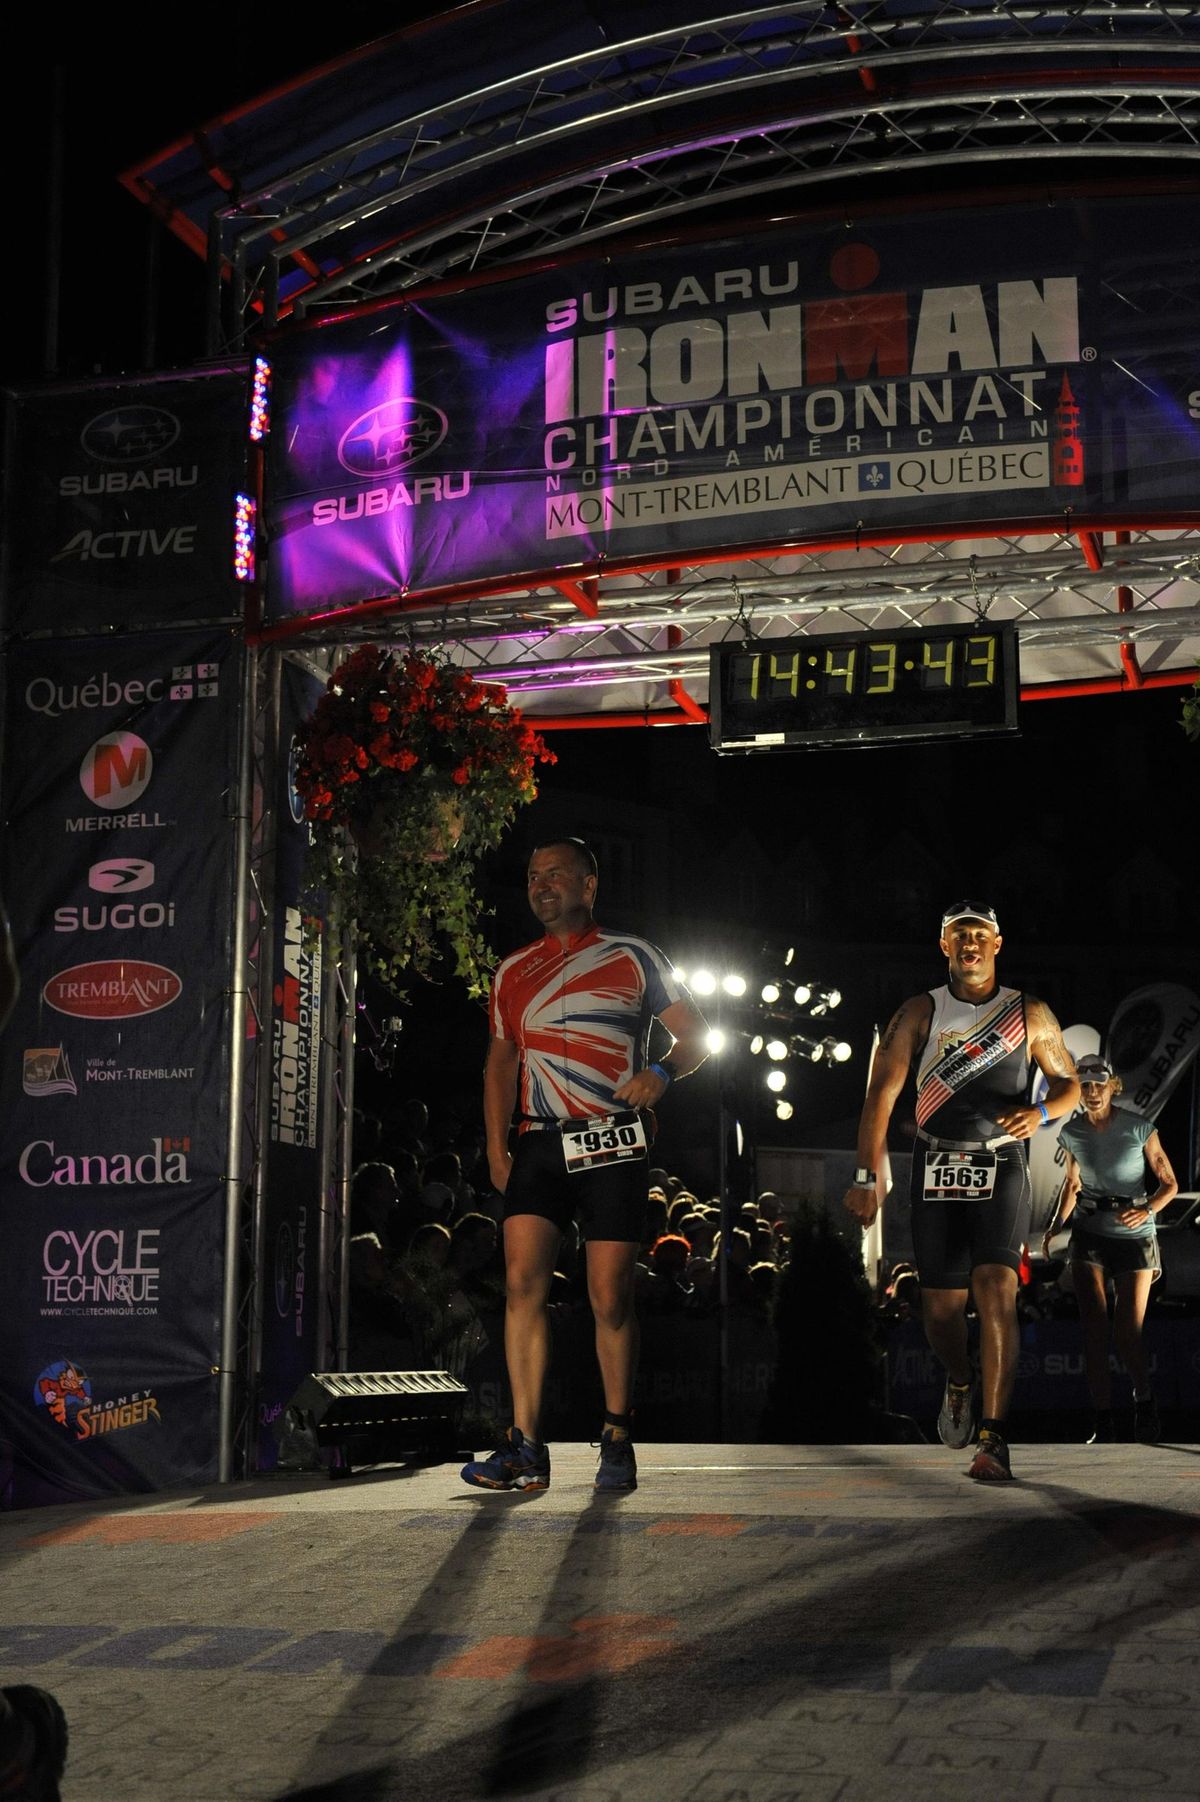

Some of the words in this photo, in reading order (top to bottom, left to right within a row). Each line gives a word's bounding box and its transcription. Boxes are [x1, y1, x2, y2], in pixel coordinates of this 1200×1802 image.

[545, 260, 799, 333] SUBARU
[545, 275, 1080, 426] IRONMAN
[544, 370, 1047, 471] CHAMPIONNAT
[545, 459, 669, 492] NORD
[725, 419, 1048, 467] AMÉRICAIN
[59, 464, 199, 497] SUBARU
[312, 471, 471, 526] SUBARU
[548, 466, 852, 530] MONT-TREMBLANT
[896, 451, 1044, 492] QUÉBEC
[50, 525, 198, 563] ACTIVE
[25, 672, 164, 717] Québec
[65, 812, 167, 833] MERRELL
[56, 978, 172, 1006] TREMBLANT
[278, 905, 302, 1145] IRONMAN
[86, 1058, 105, 1067] Ville
[106, 1058, 117, 1067] de
[86, 1067, 195, 1082] MONT-TREMBLANT
[939, 1032, 1002, 1081] IRONMAN
[269, 1018, 281, 1142] SUBARU
[569, 1126, 637, 1153] 1930
[18, 1137, 192, 1188] Canada
[932, 1167, 988, 1188] 1563
[43, 1229, 161, 1276] CYCLE
[40, 1307, 158, 1317] WWW.CYCLETECHNIQUE.COM
[41, 1275, 160, 1306] TECHNIQUE
[75, 1397, 162, 1440] STINGER
[92, 1389, 153, 1412] HONEY
